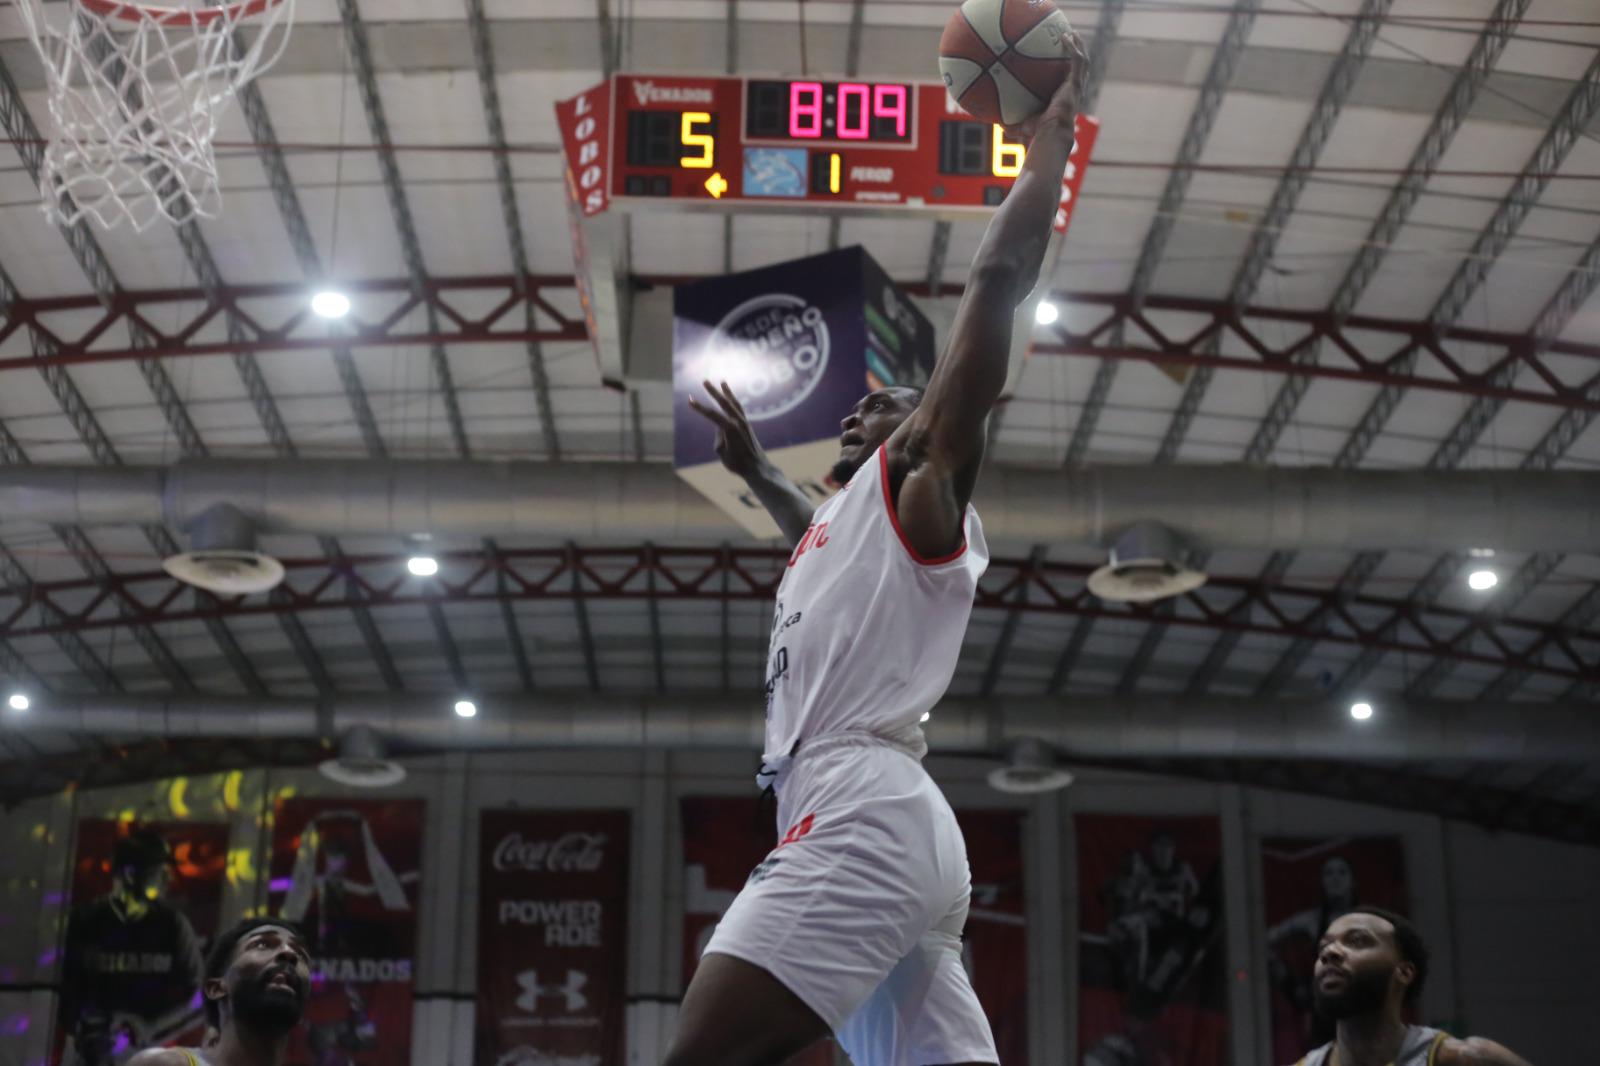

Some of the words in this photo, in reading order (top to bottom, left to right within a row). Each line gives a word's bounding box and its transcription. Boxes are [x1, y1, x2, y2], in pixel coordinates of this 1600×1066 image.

[633, 81, 713, 106] VENADOS
[789, 81, 907, 139] 8:09
[574, 95, 603, 214] LOBOS
[680, 111, 714, 169] 5
[992, 122, 1026, 178] 6
[829, 152, 841, 194] 1
[499, 900, 603, 926] POWER
